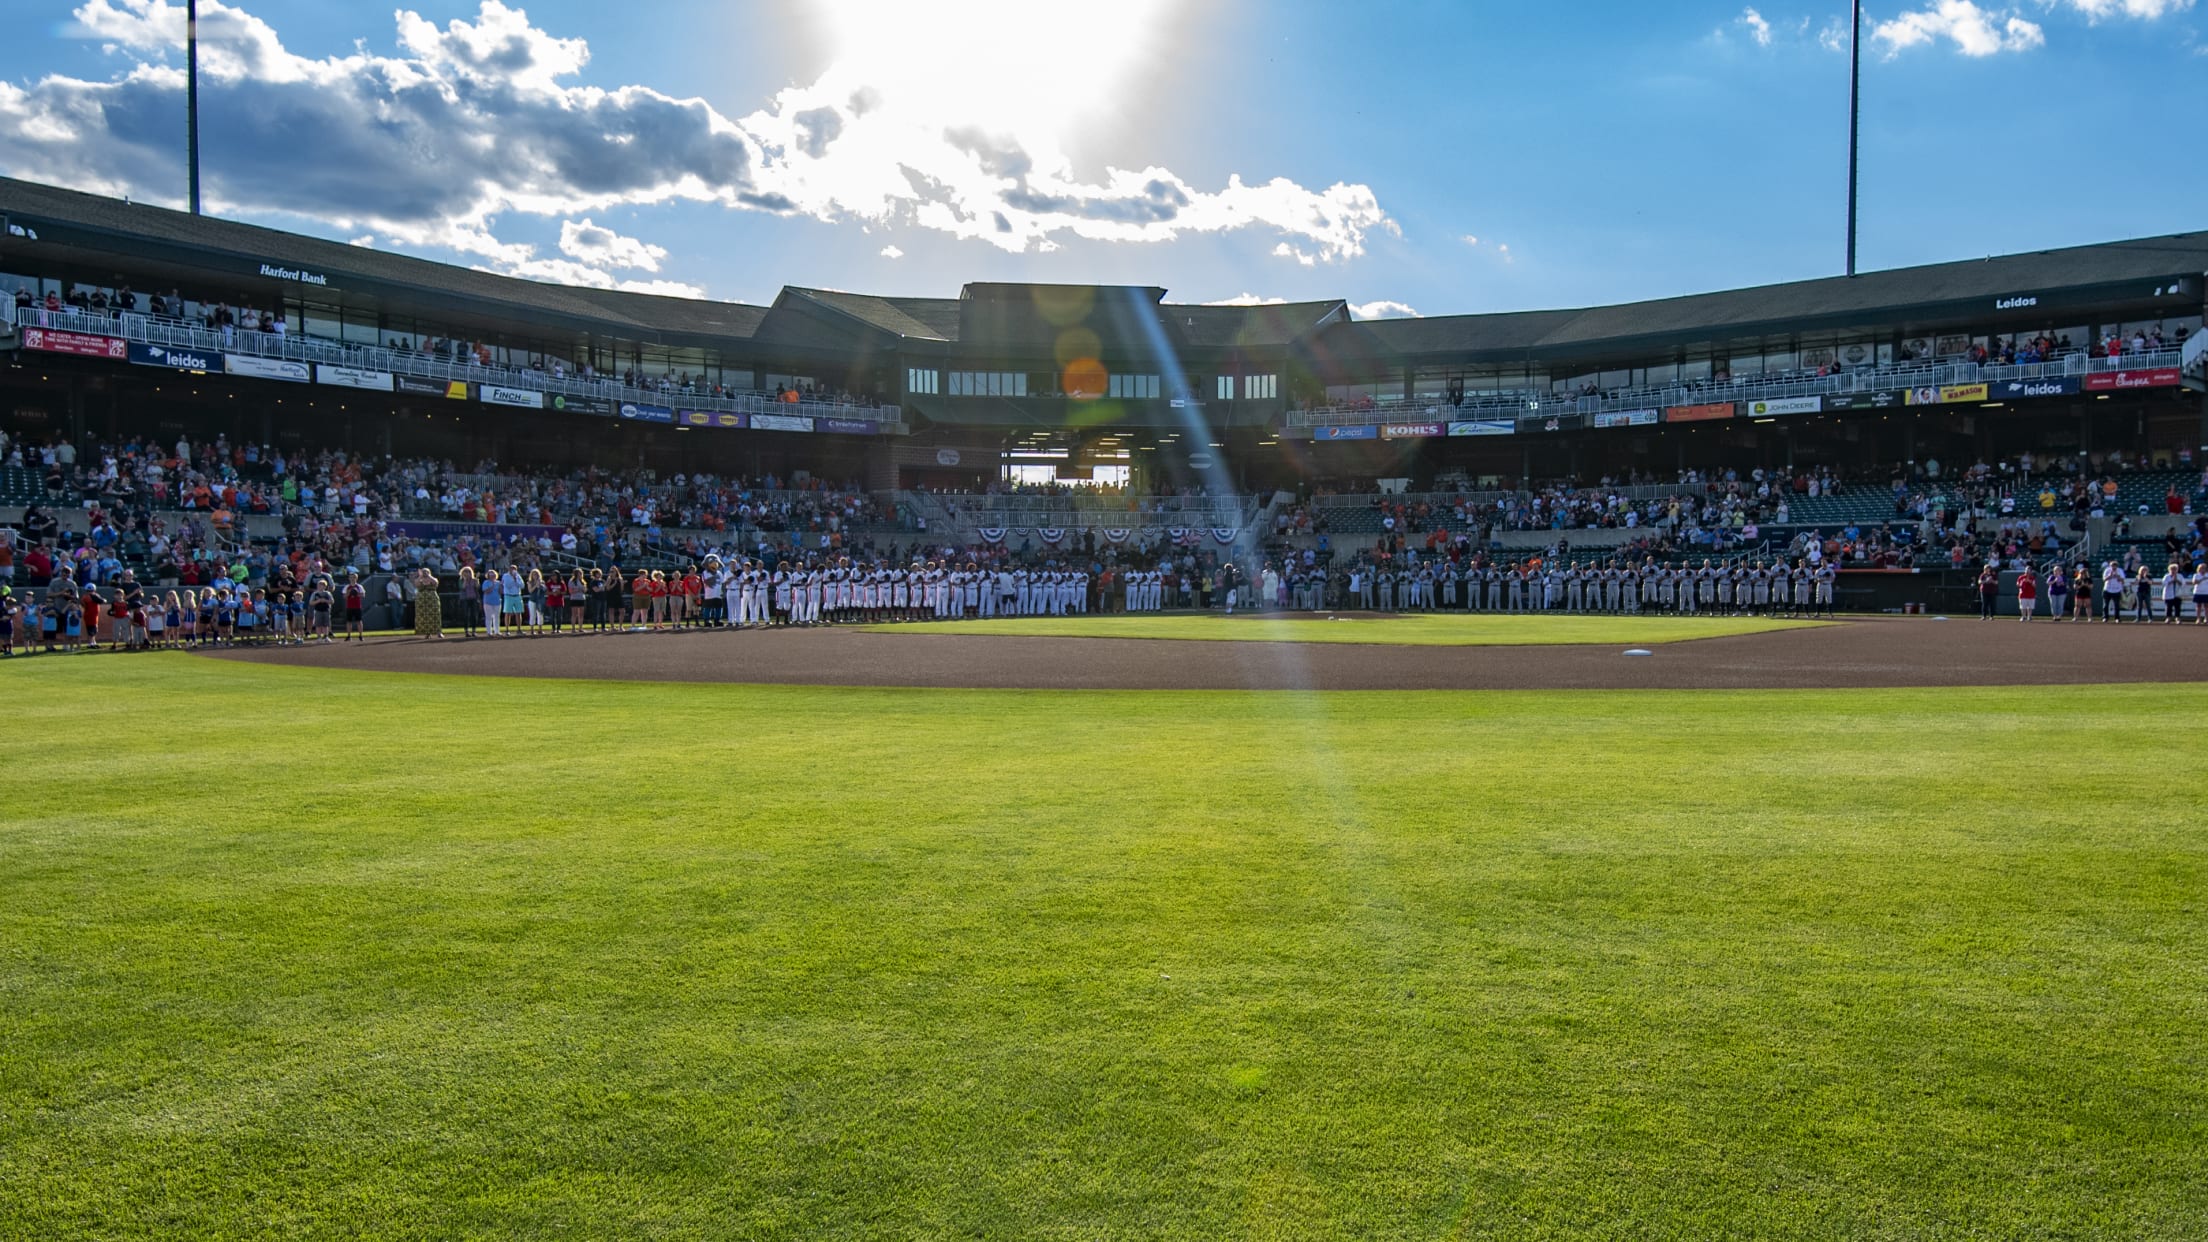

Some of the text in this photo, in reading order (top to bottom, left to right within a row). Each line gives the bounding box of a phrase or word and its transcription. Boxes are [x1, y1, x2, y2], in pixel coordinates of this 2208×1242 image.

[260, 264, 327, 286] Harford Bank
[1996, 297, 2037, 309] Leidos
[166, 351, 207, 368] leidos
[493, 388, 522, 401] FINCH
[2024, 383, 2063, 396] leidos
[1769, 402, 1815, 412] JOHN DEERE
[1340, 428, 1362, 438] pepsi
[1387, 425, 1438, 436] KOHL'S
